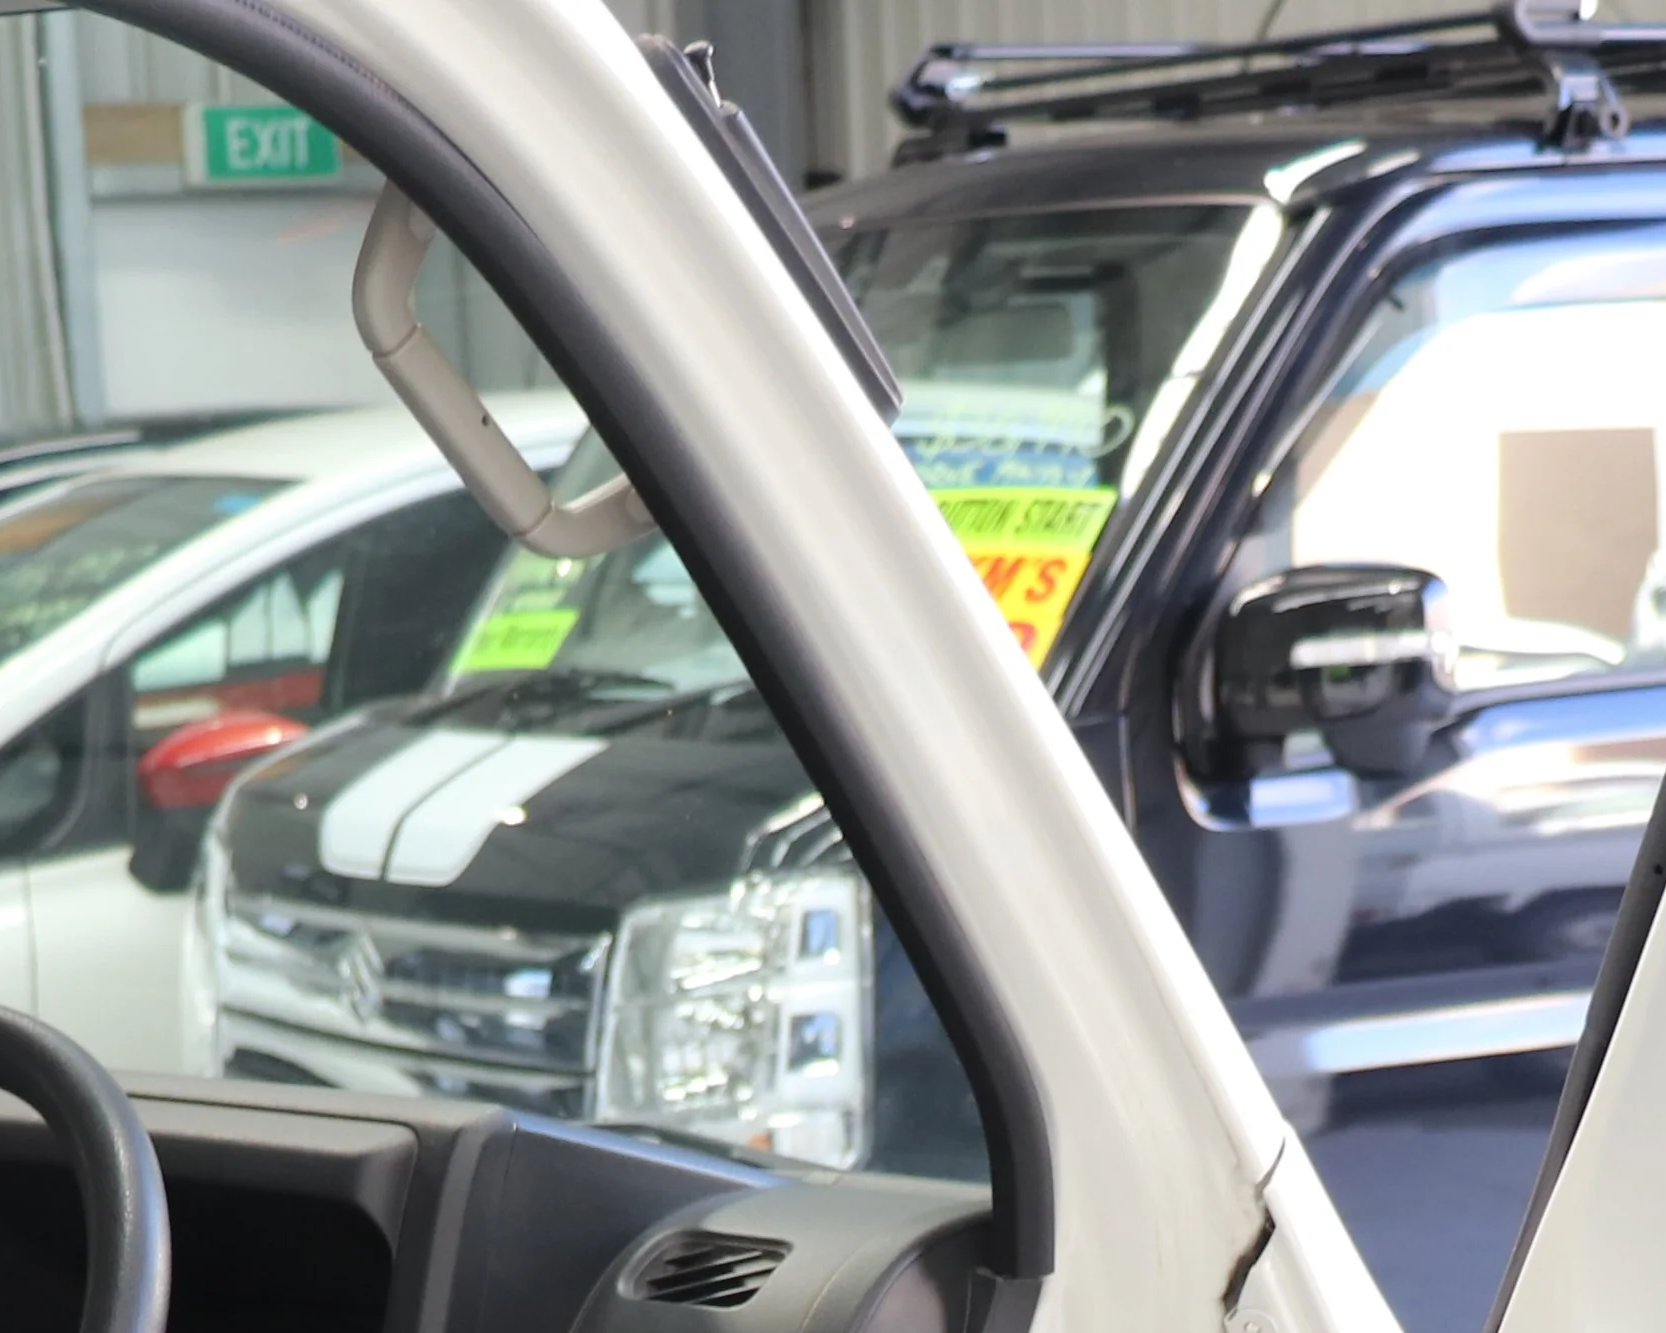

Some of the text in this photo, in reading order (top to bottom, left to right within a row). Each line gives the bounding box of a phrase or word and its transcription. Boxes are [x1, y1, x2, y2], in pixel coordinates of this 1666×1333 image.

[226, 116, 310, 171] EXIT
[1015, 498, 1106, 537] START
[967, 555, 1067, 604] M'S
